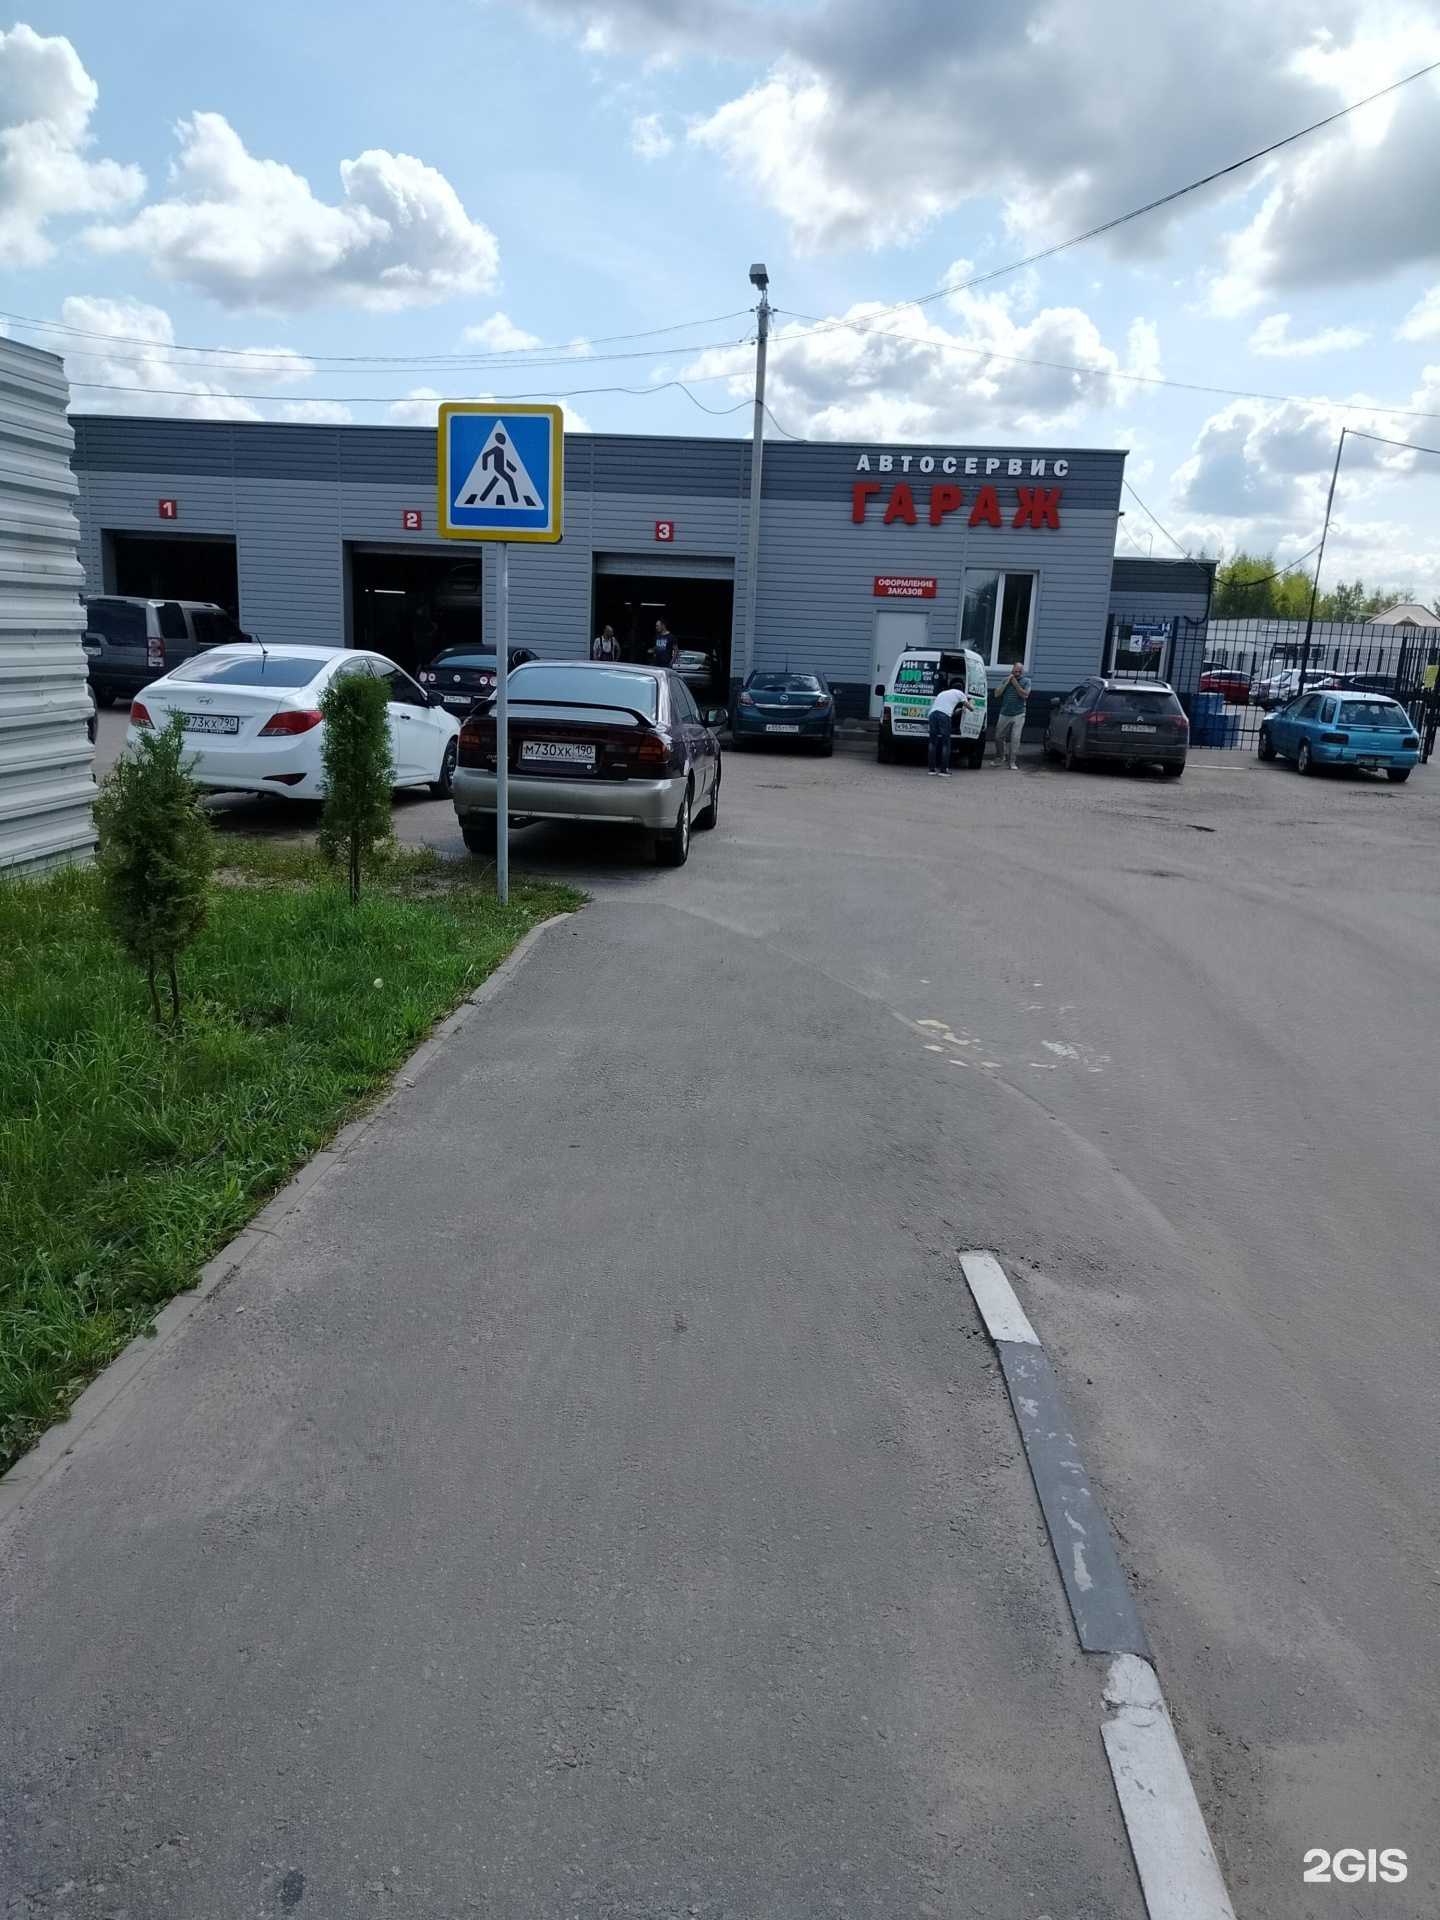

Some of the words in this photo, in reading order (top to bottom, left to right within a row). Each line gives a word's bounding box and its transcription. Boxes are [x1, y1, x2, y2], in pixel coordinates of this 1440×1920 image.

[856, 454, 1070, 477] АВТОСЕРВИС
[163, 501, 173, 517] 1
[851, 481, 1063, 529] ГАРАЖ
[406, 513, 419, 528] 2
[658, 524, 670, 539] 3
[878, 578, 933, 588] ОФОРМЛЕНИЕ
[887, 586, 923, 596] ЗАКАЗОВ
